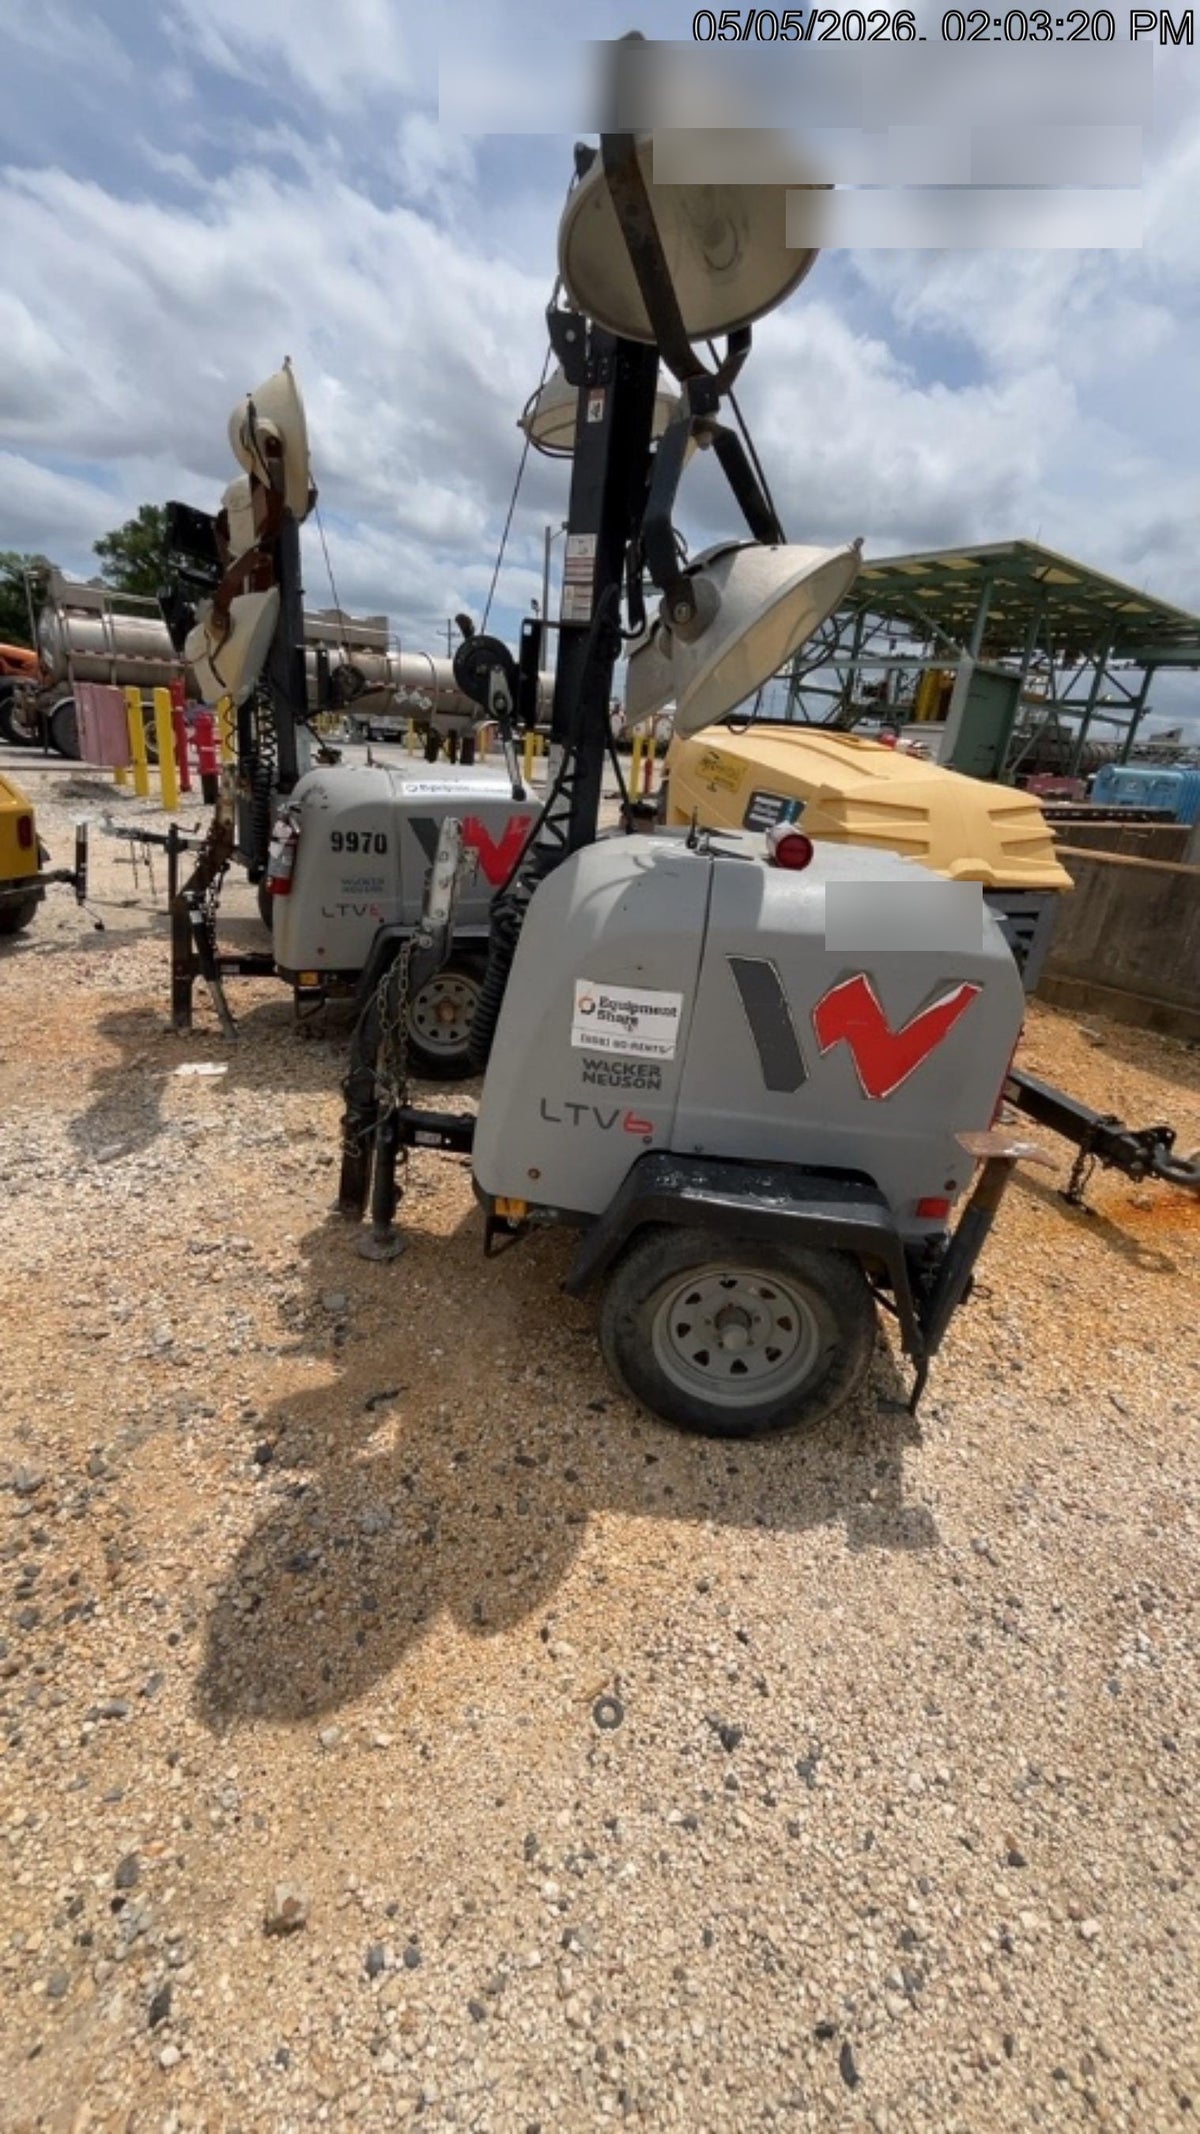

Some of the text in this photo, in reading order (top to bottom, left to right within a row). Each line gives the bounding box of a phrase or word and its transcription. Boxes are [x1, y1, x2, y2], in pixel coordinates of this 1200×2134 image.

[331, 831, 388, 854] 9970
[597, 1009, 639, 1025] Share
[599, 996, 677, 1018] Equipment
[582, 1058, 661, 1077] WACKER
[582, 1071, 661, 1090] NEUSON
[540, 1097, 653, 1134] LTV6
